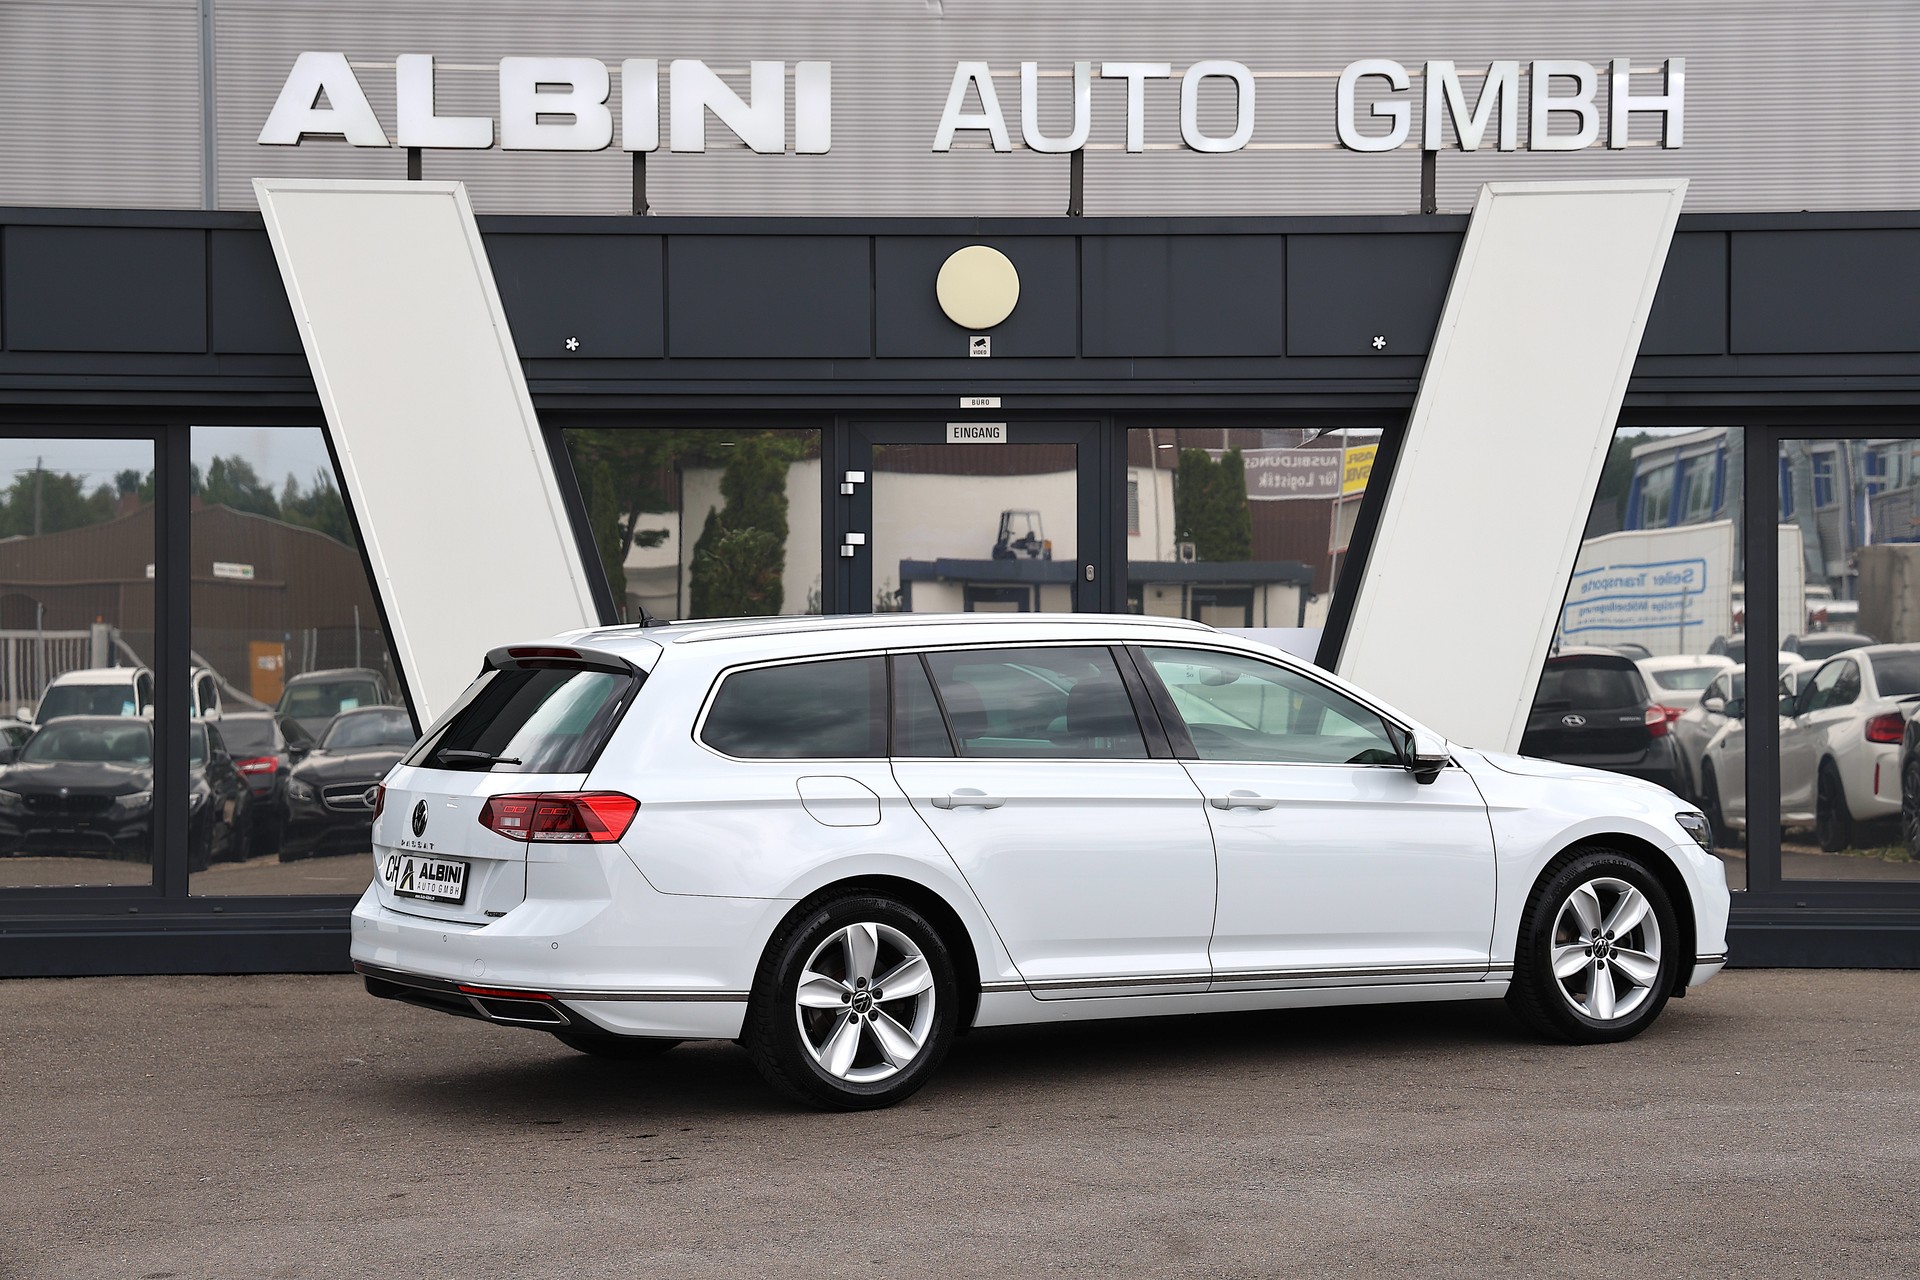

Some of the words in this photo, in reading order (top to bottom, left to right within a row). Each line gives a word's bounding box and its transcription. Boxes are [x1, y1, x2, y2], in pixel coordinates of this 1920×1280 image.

[257, 51, 832, 155] ALBINI
[932, 60, 1256, 153] AUTO
[1335, 57, 1686, 153] GMBH
[971, 398, 990, 406] BÜRO
[953, 427, 1000, 439] EINGANG
[401, 839, 434, 850] PASSAT
[385, 855, 400, 883] CH
[419, 863, 462, 883] ALBINI
[417, 882, 436, 892] AUTO
[438, 884, 460, 895] GMBH
